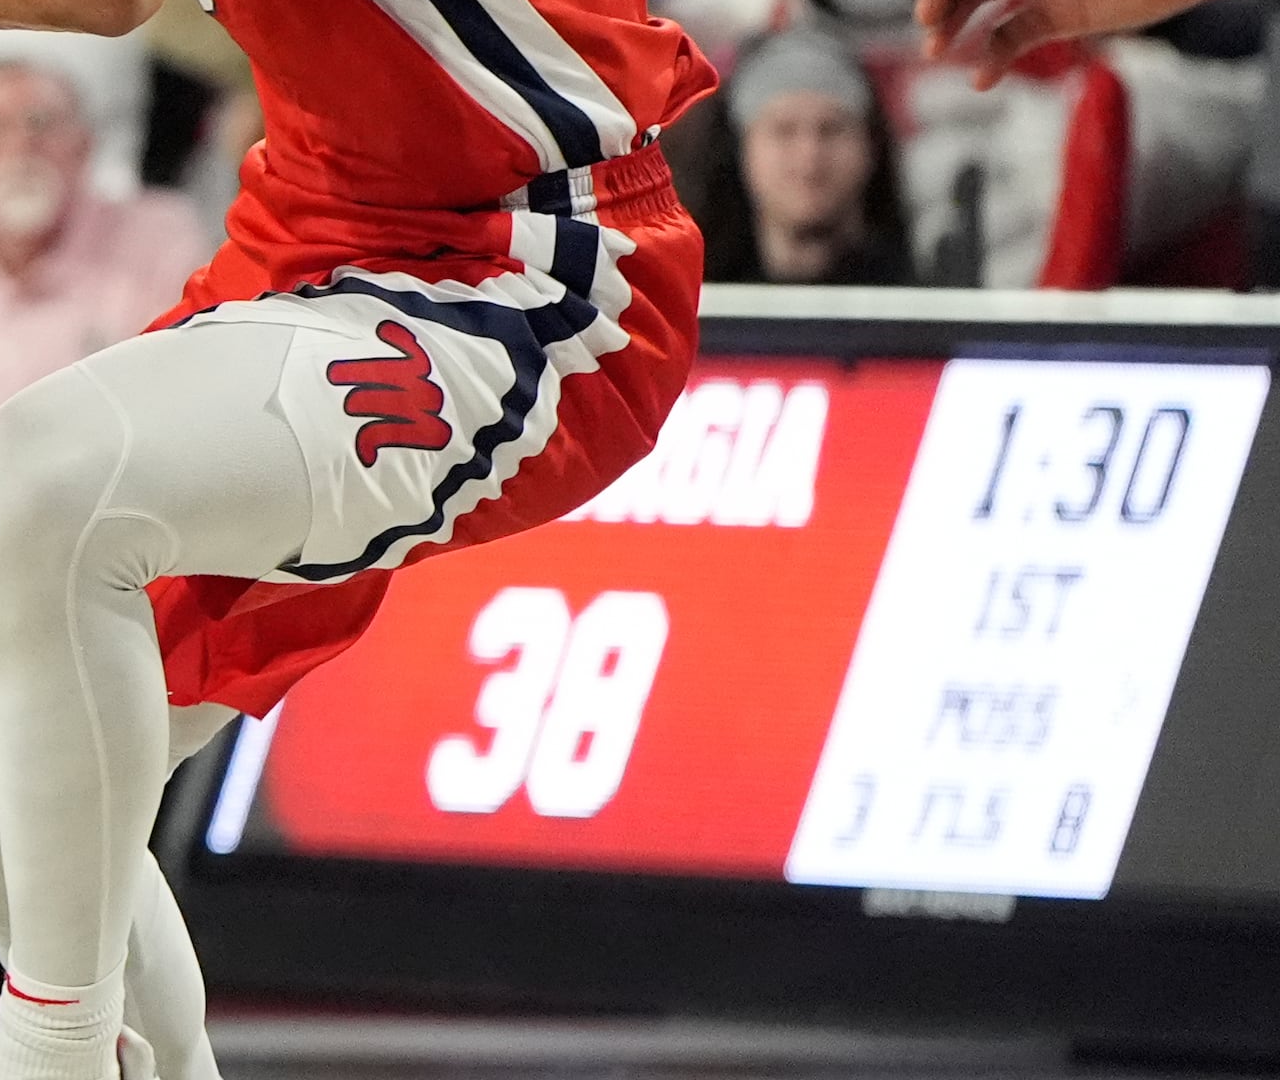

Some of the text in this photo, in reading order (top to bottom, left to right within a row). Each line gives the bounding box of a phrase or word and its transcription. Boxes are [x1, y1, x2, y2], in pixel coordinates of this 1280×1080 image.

[970, 401, 1195, 526] 1:30
[426, 587, 669, 817] 38
[1045, 779, 1095, 861] 8
